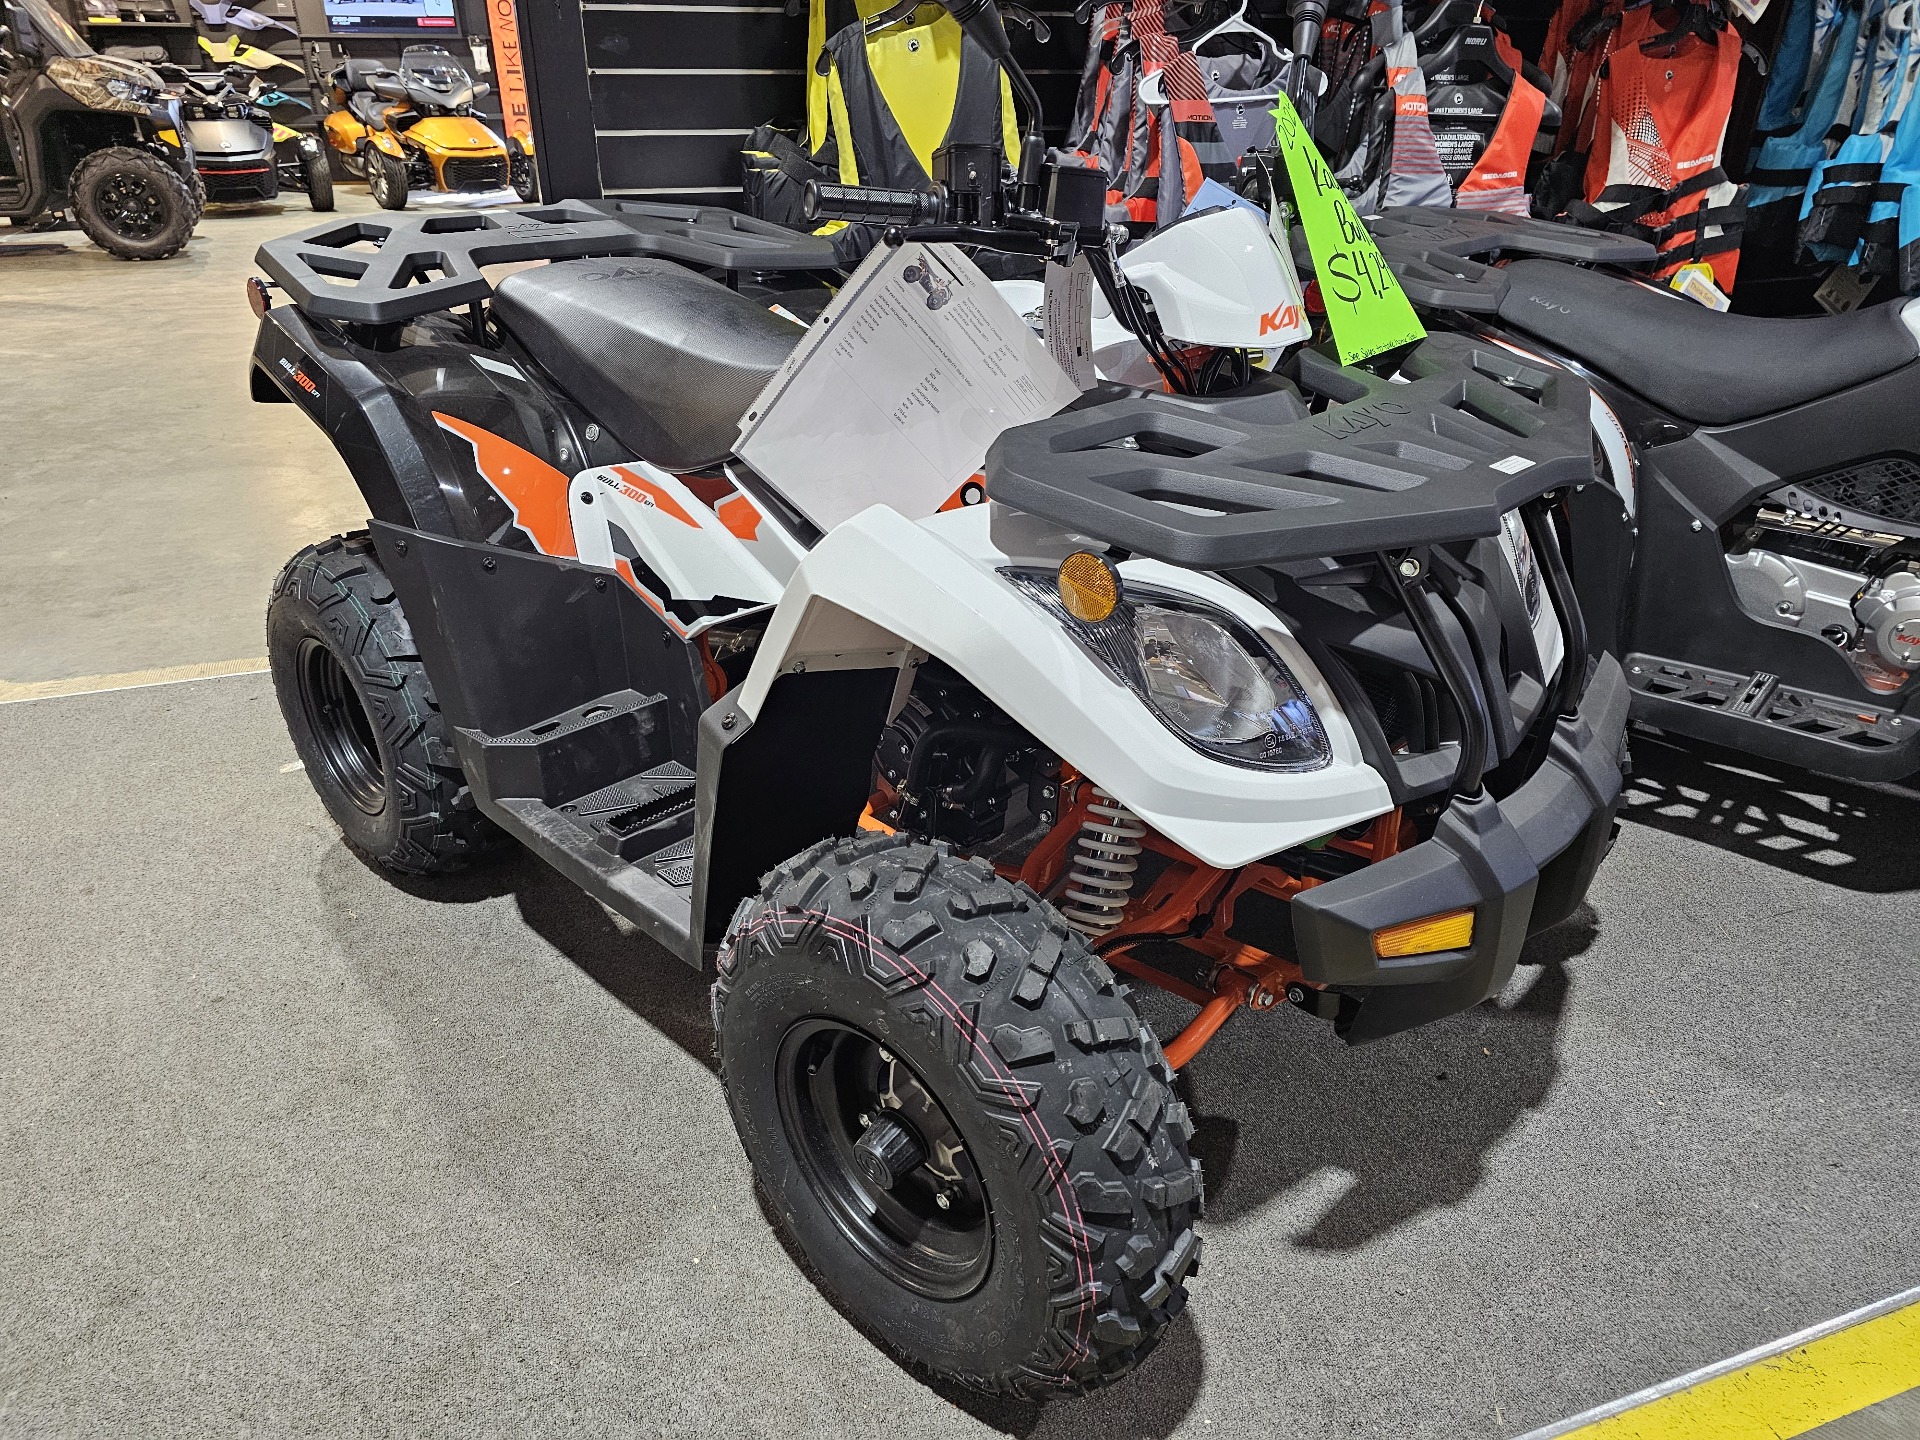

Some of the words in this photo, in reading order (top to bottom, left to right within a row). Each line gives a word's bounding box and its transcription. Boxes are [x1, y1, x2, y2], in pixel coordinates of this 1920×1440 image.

[1465, 37, 1487, 46] NORU
[504, 40, 526, 93] LIKE
[1688, 281, 1705, 295] Think
[279, 357, 296, 376] BULL
[293, 370, 317, 393] 300
[1313, 402, 1412, 440] KAYO
[597, 474, 621, 490] BULL
[617, 484, 648, 504] 300
